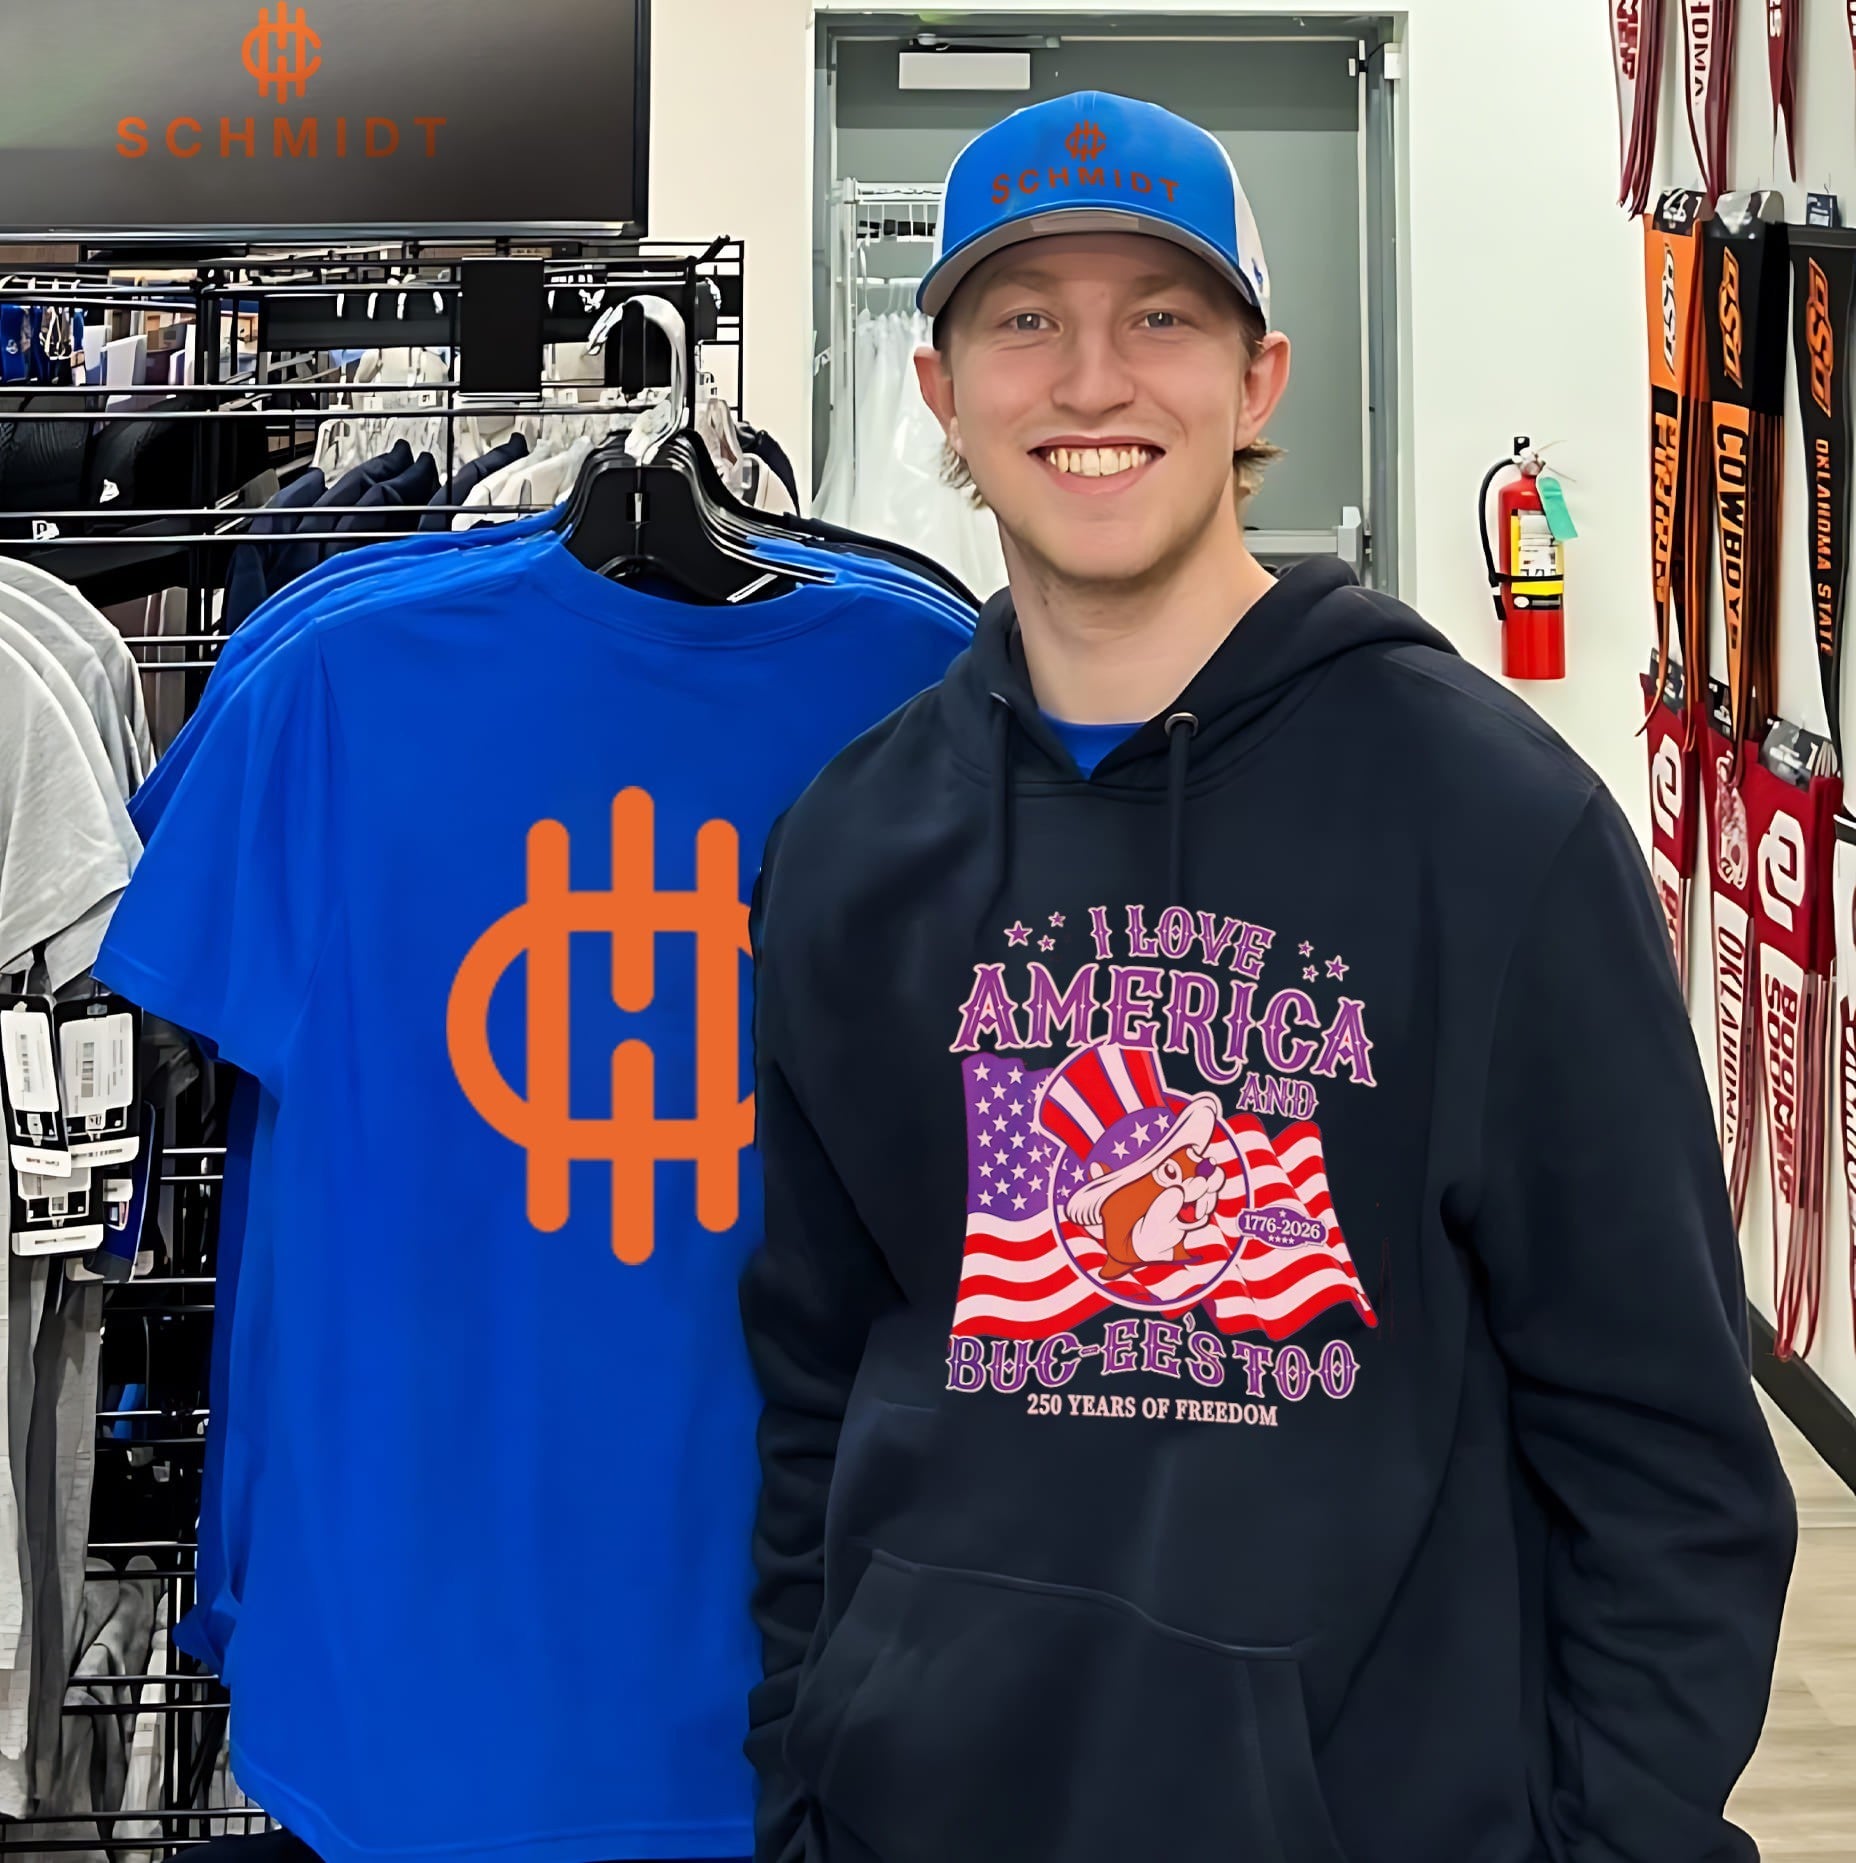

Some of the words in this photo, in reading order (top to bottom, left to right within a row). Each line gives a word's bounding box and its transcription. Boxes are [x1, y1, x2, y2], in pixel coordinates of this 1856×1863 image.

[116, 116, 448, 159] SCHMIDT
[991, 166, 1179, 205] SCHMIDT
[1814, 437, 1833, 571] OKLAHOMA
[1088, 904, 1113, 961] I
[1125, 903, 1277, 981] LOVE
[948, 961, 1378, 1088] AMERICA
[1236, 1071, 1319, 1121] AND
[1242, 1213, 1321, 1240] 1776-2026
[945, 1312, 1227, 1394] BUC-EE'S
[1233, 1337, 1361, 1403] TOO
[1026, 1393, 1062, 1416] 250
[1068, 1394, 1136, 1418] YEARS
[1142, 1396, 1170, 1420] OF
[1175, 1398, 1279, 1427] FREEDOM
